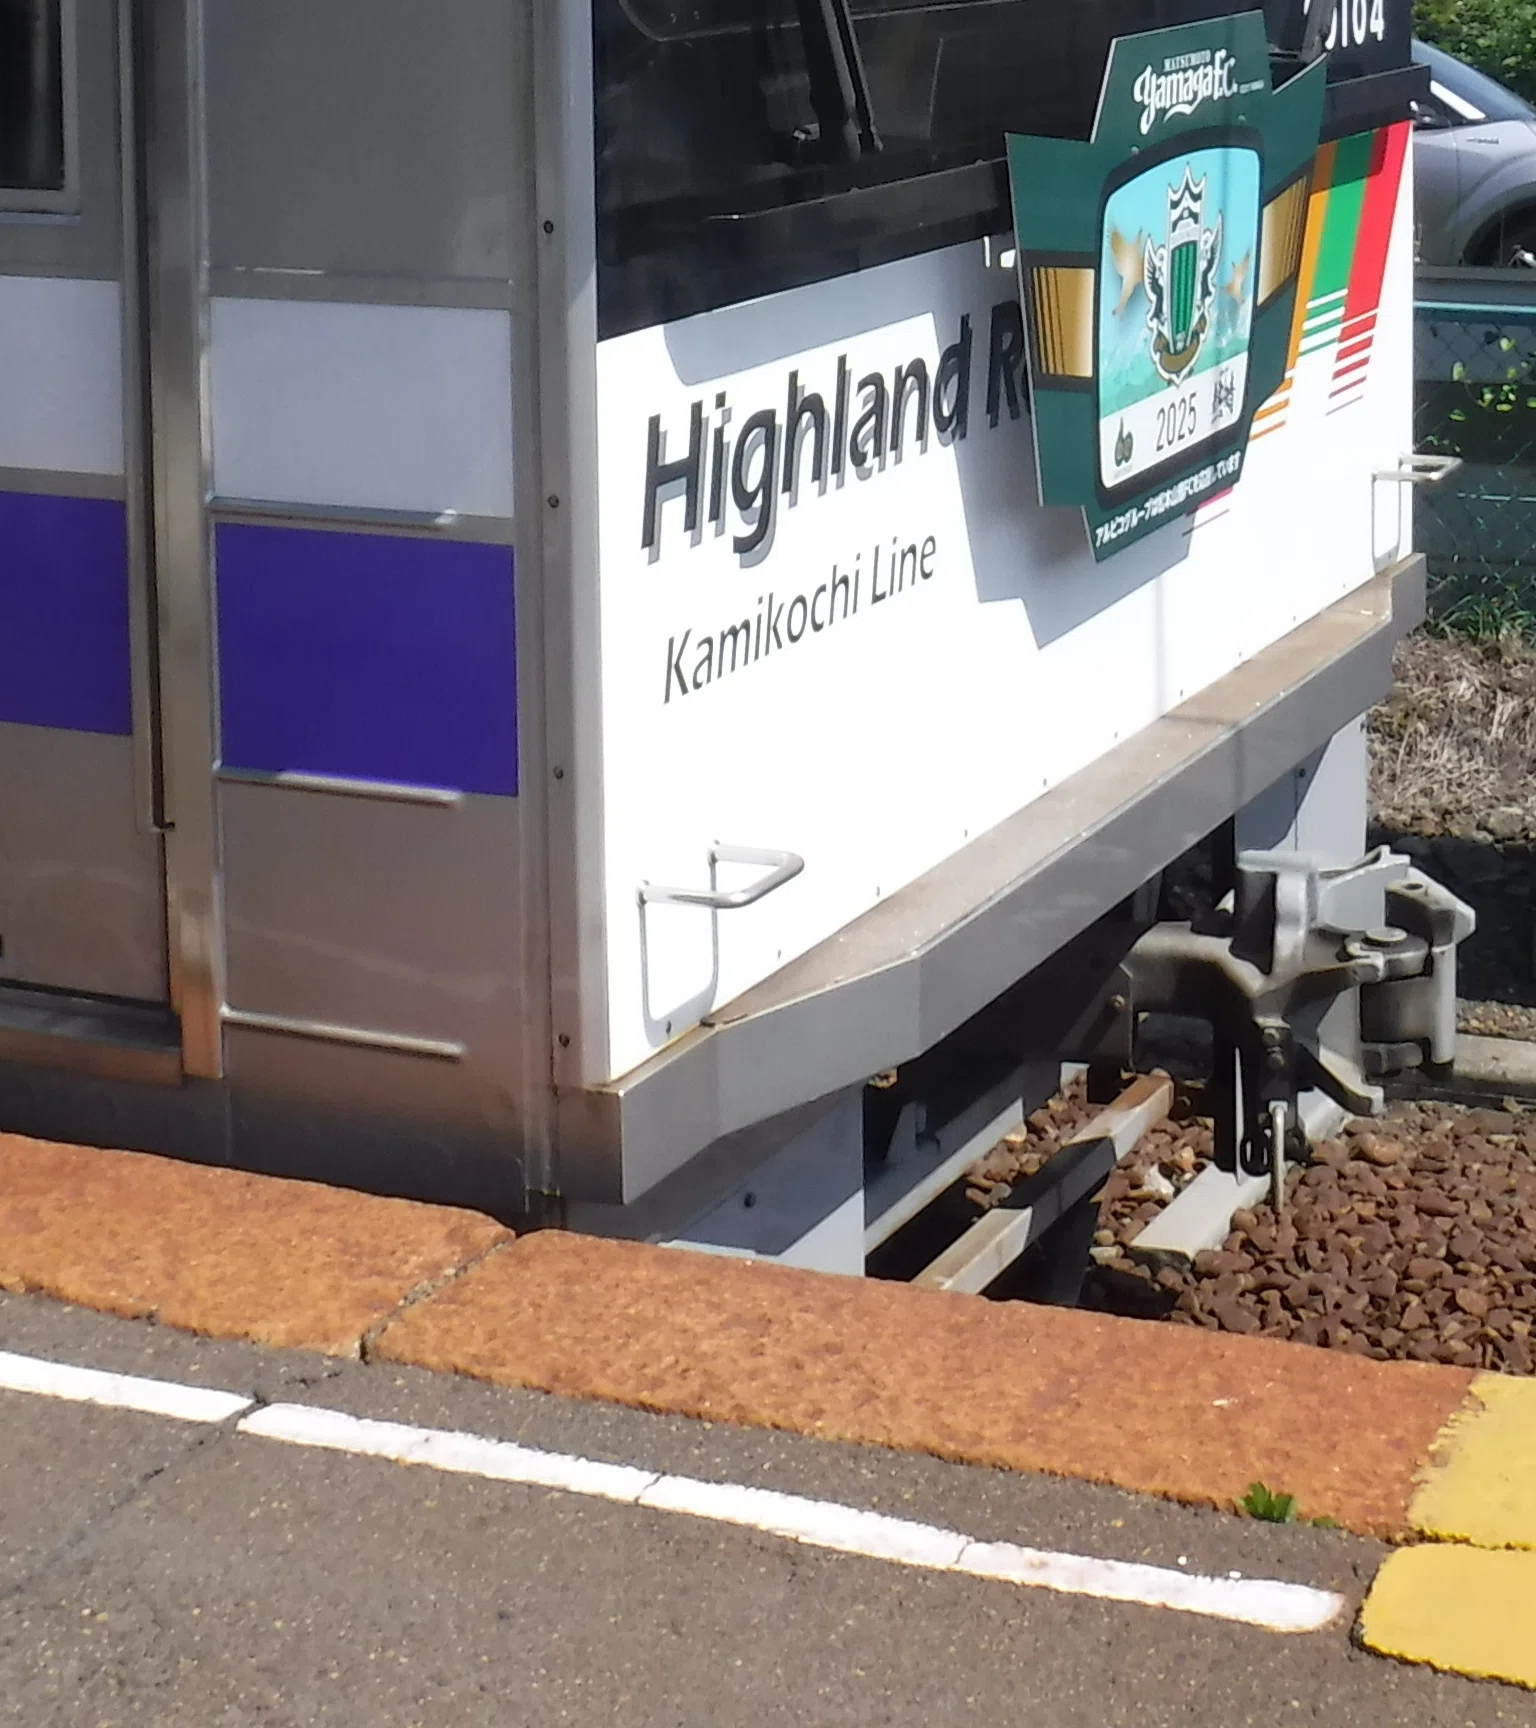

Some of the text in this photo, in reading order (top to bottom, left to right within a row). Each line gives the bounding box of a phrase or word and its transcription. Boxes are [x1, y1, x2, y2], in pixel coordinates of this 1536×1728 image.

[641, 312, 973, 556] Highland
[1155, 392, 1198, 452] 2025
[664, 534, 937, 705] Kamikochi Line
